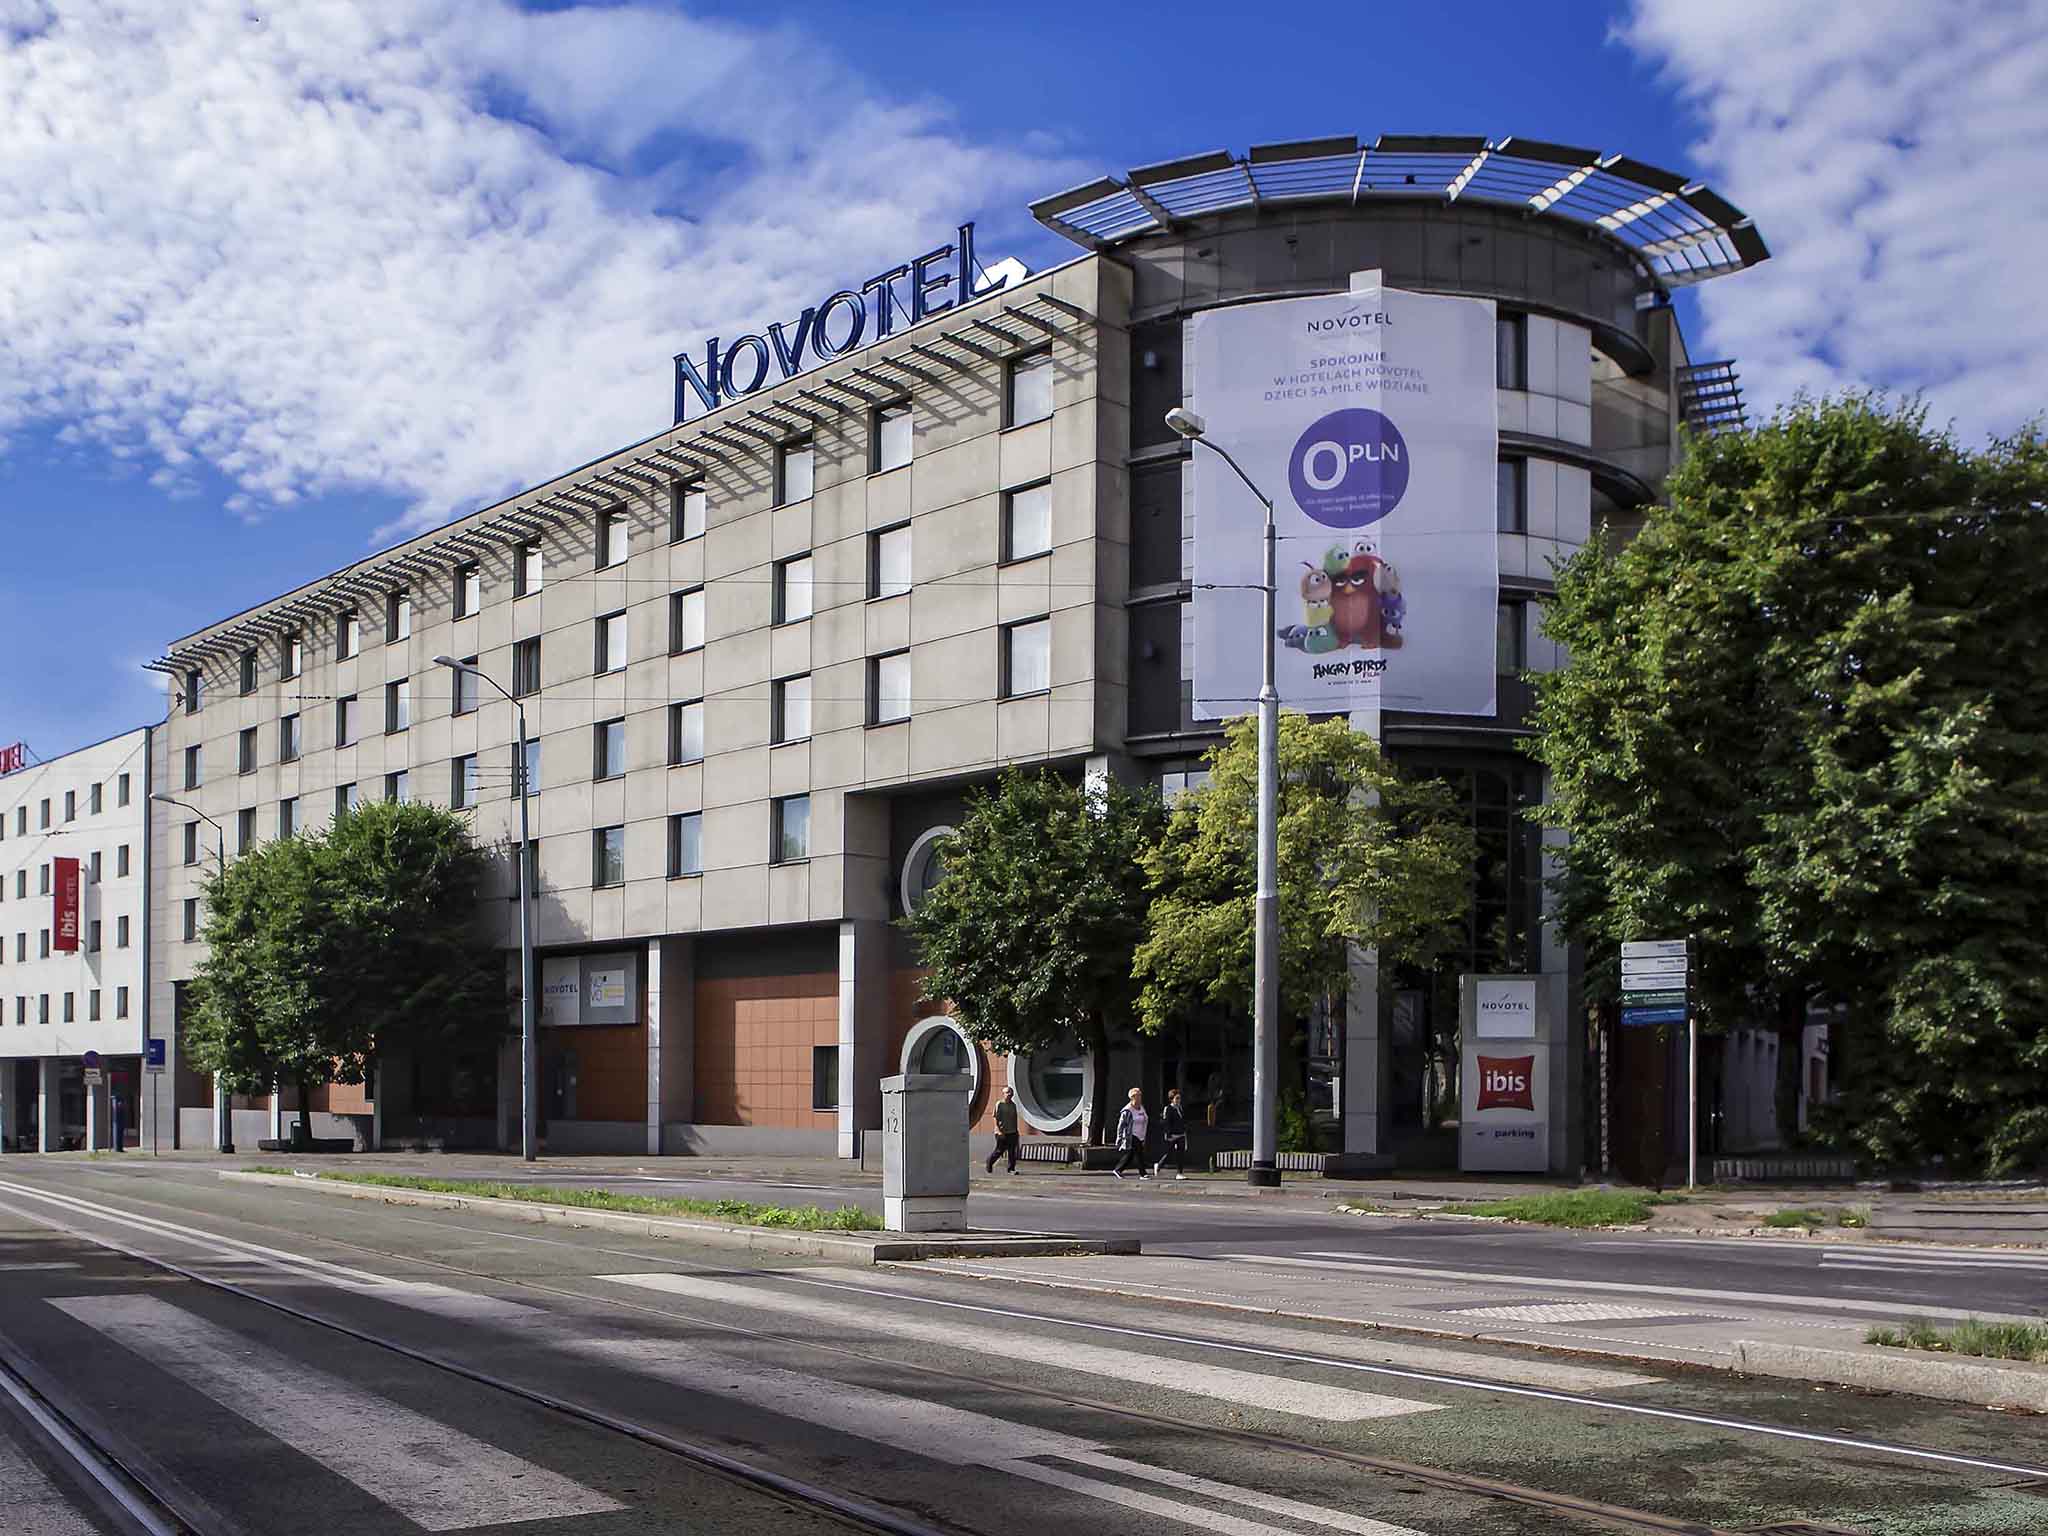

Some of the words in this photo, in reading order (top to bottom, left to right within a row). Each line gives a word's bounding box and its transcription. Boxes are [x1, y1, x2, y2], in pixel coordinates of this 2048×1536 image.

[672, 221, 1007, 427] NOVOTEL
[1307, 312, 1393, 333] NOVOTEL
[1310, 352, 1388, 369] SPOKOJNIE
[1273, 376, 1286, 386] W
[1290, 368, 1361, 385] HOTELACH
[1365, 366, 1423, 379] NOVOTEL
[1264, 388, 1307, 401] DZIECI
[1331, 382, 1362, 393] MILE
[1367, 379, 1430, 394] WIDZIANE
[1349, 442, 1399, 463] PLN
[1313, 663, 1351, 679] ANGRY
[1352, 658, 1387, 675] BIRDS
[61, 911, 77, 937] ibis
[544, 983, 578, 994] NOVOTEL
[1482, 1001, 1530, 1010] NOVOTEL
[1486, 1070, 1525, 1092] ibis
[1495, 1128, 1535, 1138] parking
